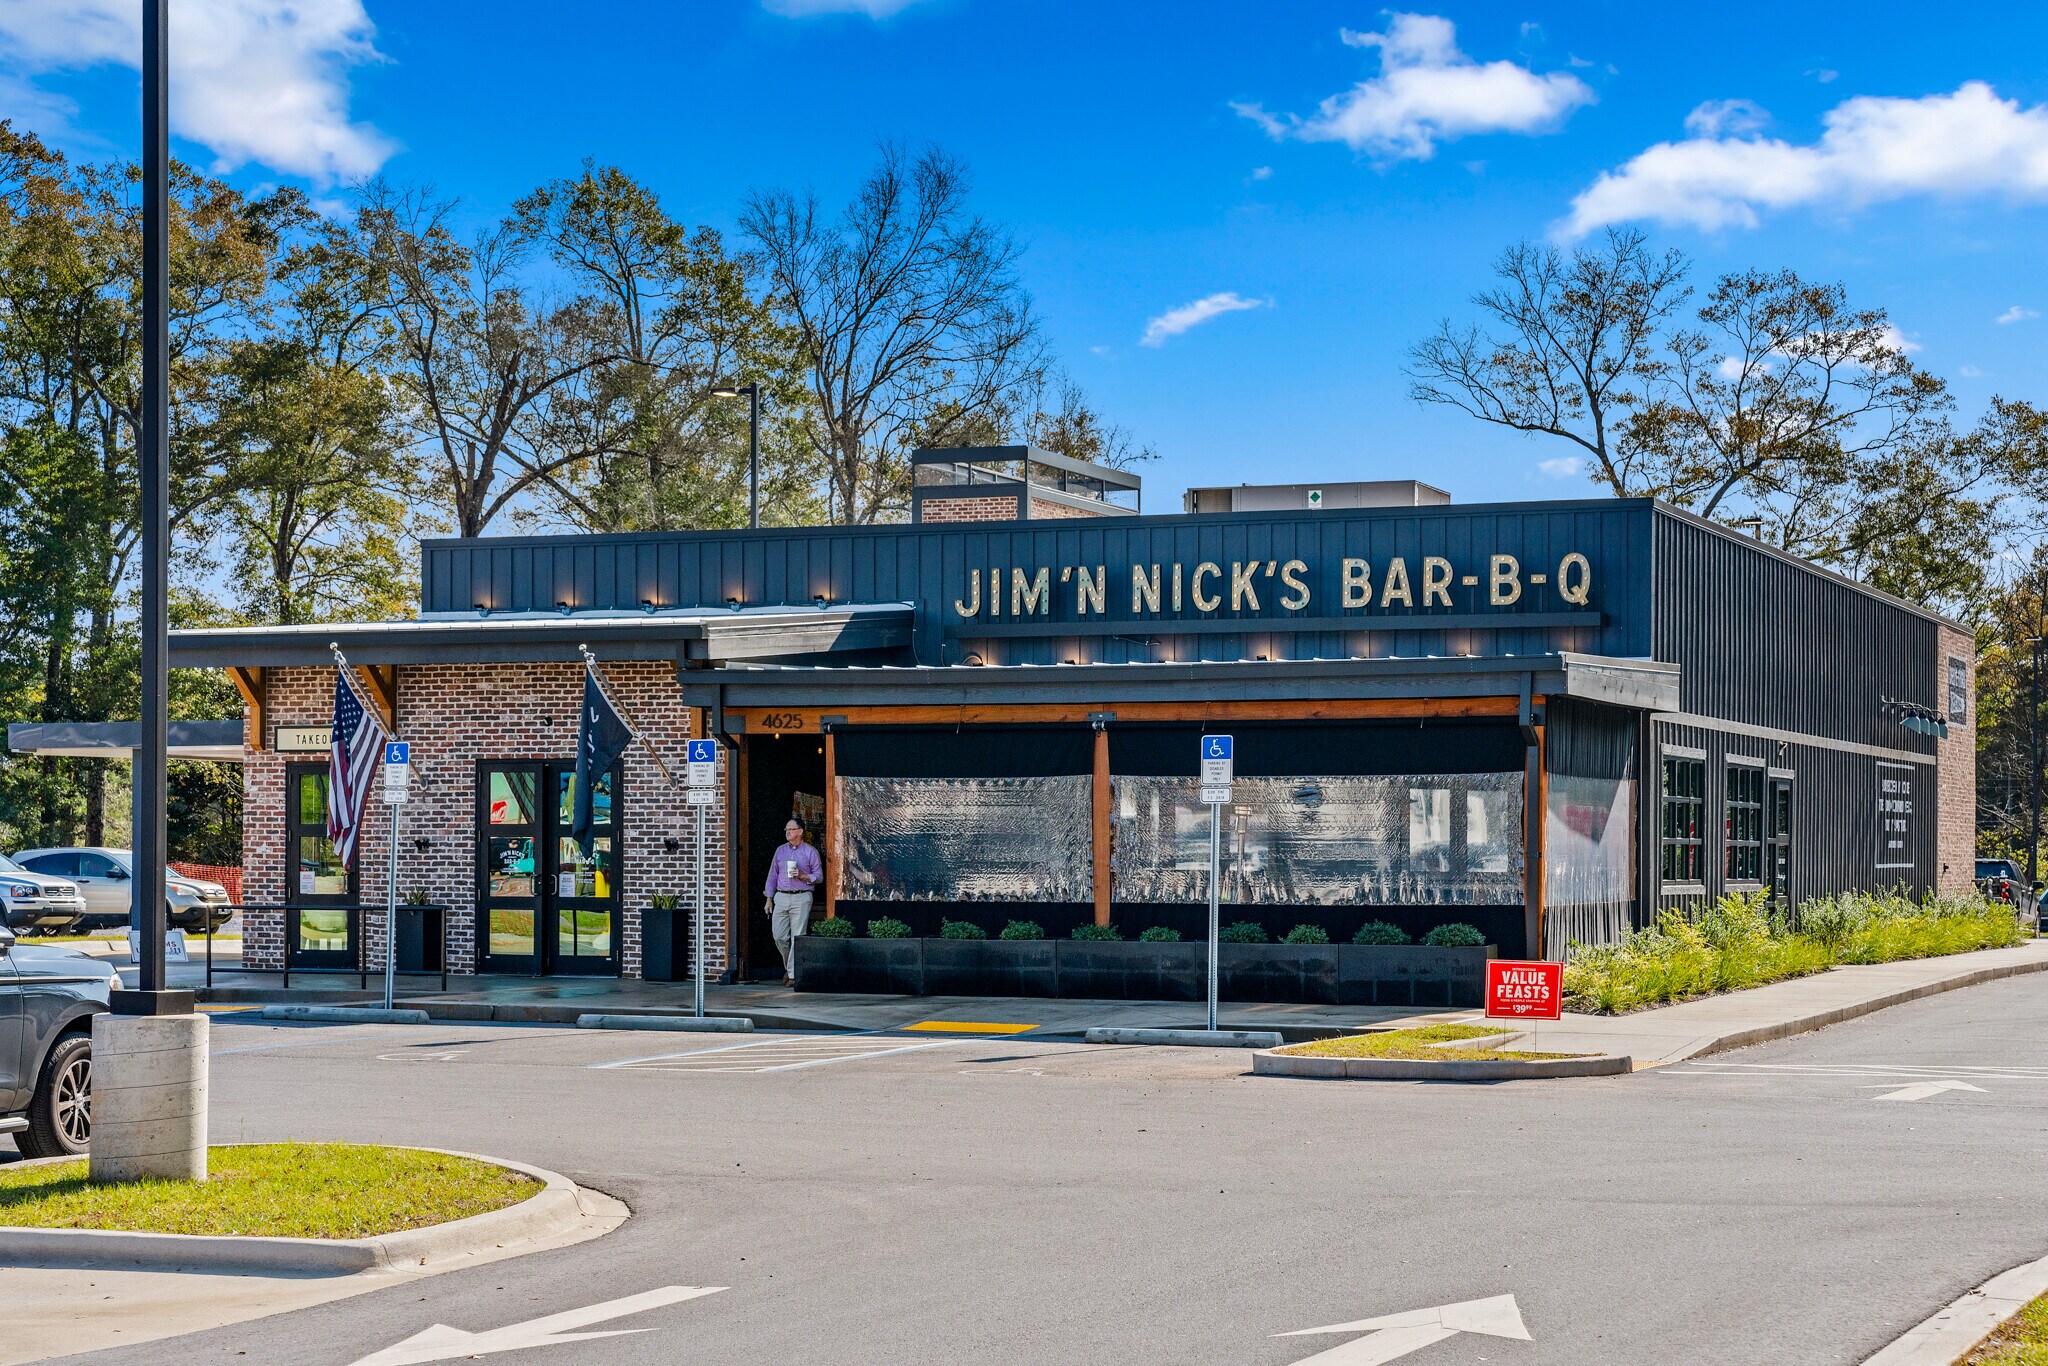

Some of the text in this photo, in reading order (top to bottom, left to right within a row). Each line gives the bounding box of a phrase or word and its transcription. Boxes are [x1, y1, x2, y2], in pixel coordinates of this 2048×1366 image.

[954, 552, 1591, 617] JIM'N NICK'S BAR-B-Q
[762, 713, 803, 729] 4625
[296, 734, 332, 745] TAKEO
[1501, 971, 1547, 985] VALUE
[1497, 984, 1550, 999] FEASTS
